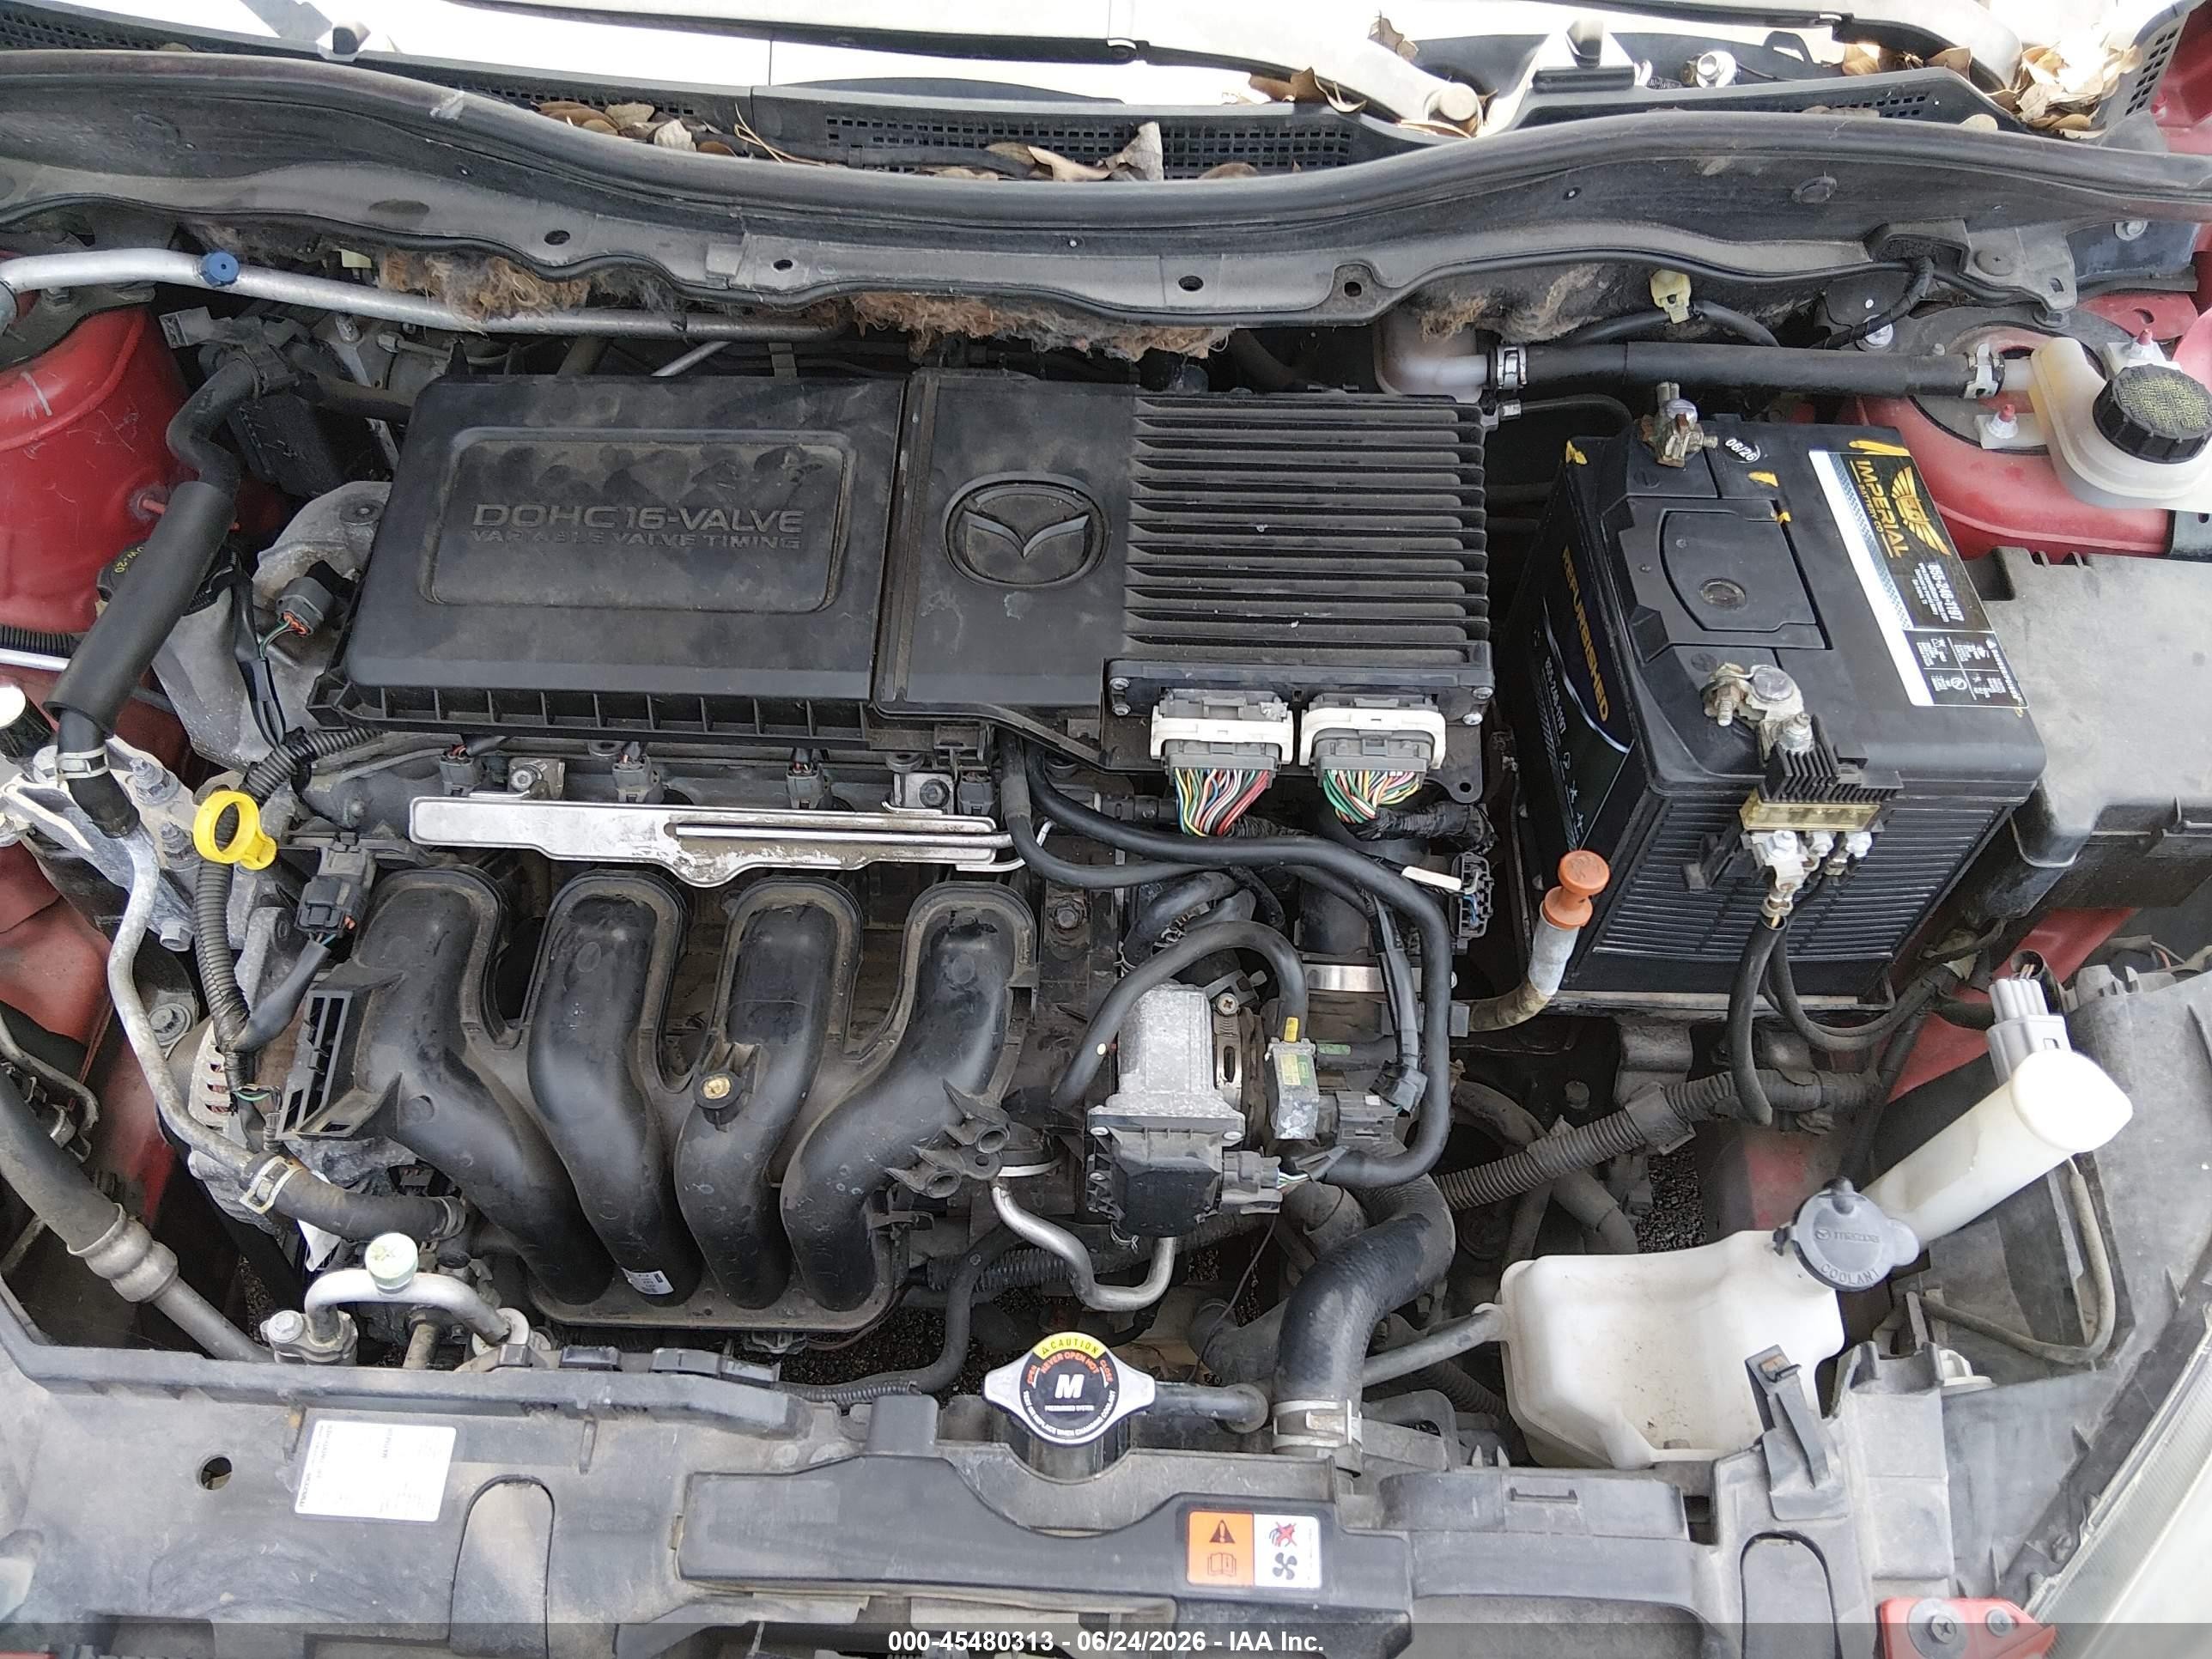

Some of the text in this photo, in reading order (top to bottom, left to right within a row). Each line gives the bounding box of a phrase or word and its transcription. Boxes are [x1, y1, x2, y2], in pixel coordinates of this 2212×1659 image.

[1725, 438, 1757, 461] 06/26
[473, 503, 805, 534] DOHC 16-VALVE
[1856, 459, 1909, 558] IMPERIAL
[1857, 484, 1884, 533] BATTERY CO
[469, 529, 802, 550] VARIABLE VALVE TIMING
[1562, 544, 1609, 722] REFURBISHED
[1833, 1231, 1881, 1243] mazda
[1820, 1263, 1880, 1285] COOLANT
[1050, 1338, 1098, 1354] CAUTION
[1041, 1352, 1100, 1374] NEVER OPEN HOT
[1099, 1359, 1114, 1382] CLOSE
[1054, 1374, 1085, 1399] M
